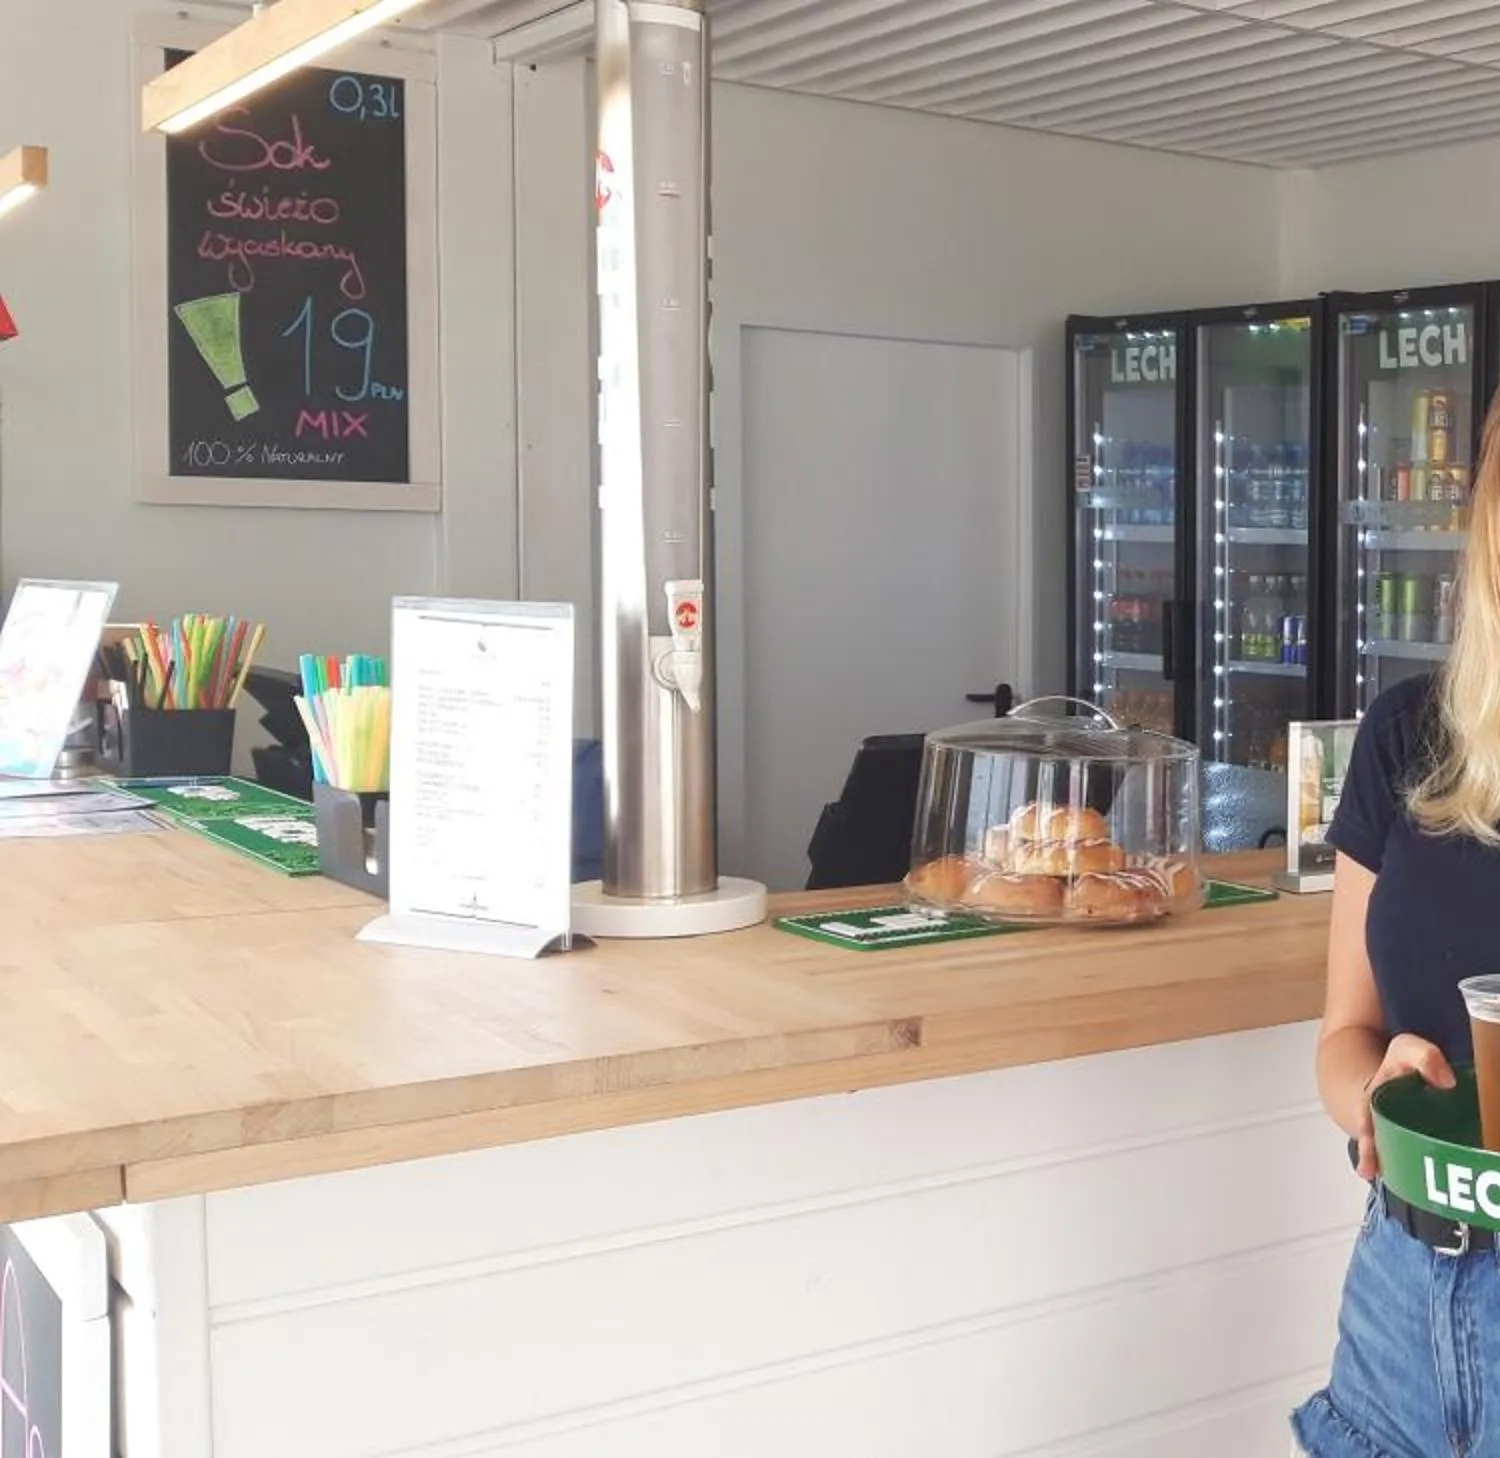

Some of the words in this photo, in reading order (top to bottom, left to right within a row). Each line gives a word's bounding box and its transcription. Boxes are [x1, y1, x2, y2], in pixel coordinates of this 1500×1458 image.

[199, 106, 331, 171] Sok
[281, 295, 375, 401] 19
[1111, 345, 1177, 383] LECH
[1378, 323, 1468, 369] LECH
[295, 410, 370, 439] MIX
